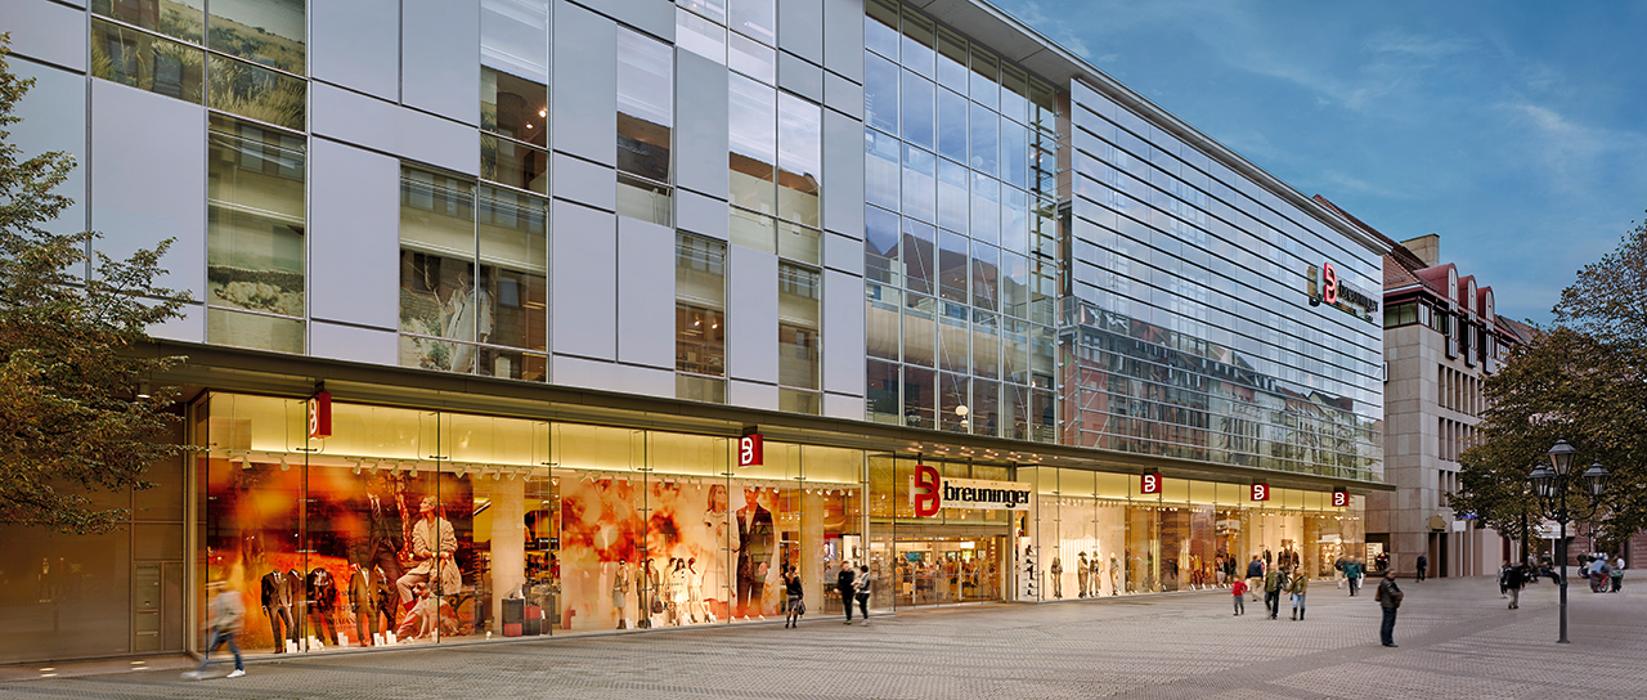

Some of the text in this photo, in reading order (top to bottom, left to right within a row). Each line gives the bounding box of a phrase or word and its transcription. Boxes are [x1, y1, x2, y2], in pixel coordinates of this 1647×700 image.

[741, 437, 753, 465] B
[915, 464, 1031, 517] B breuninger
[1144, 474, 1156, 493] B
